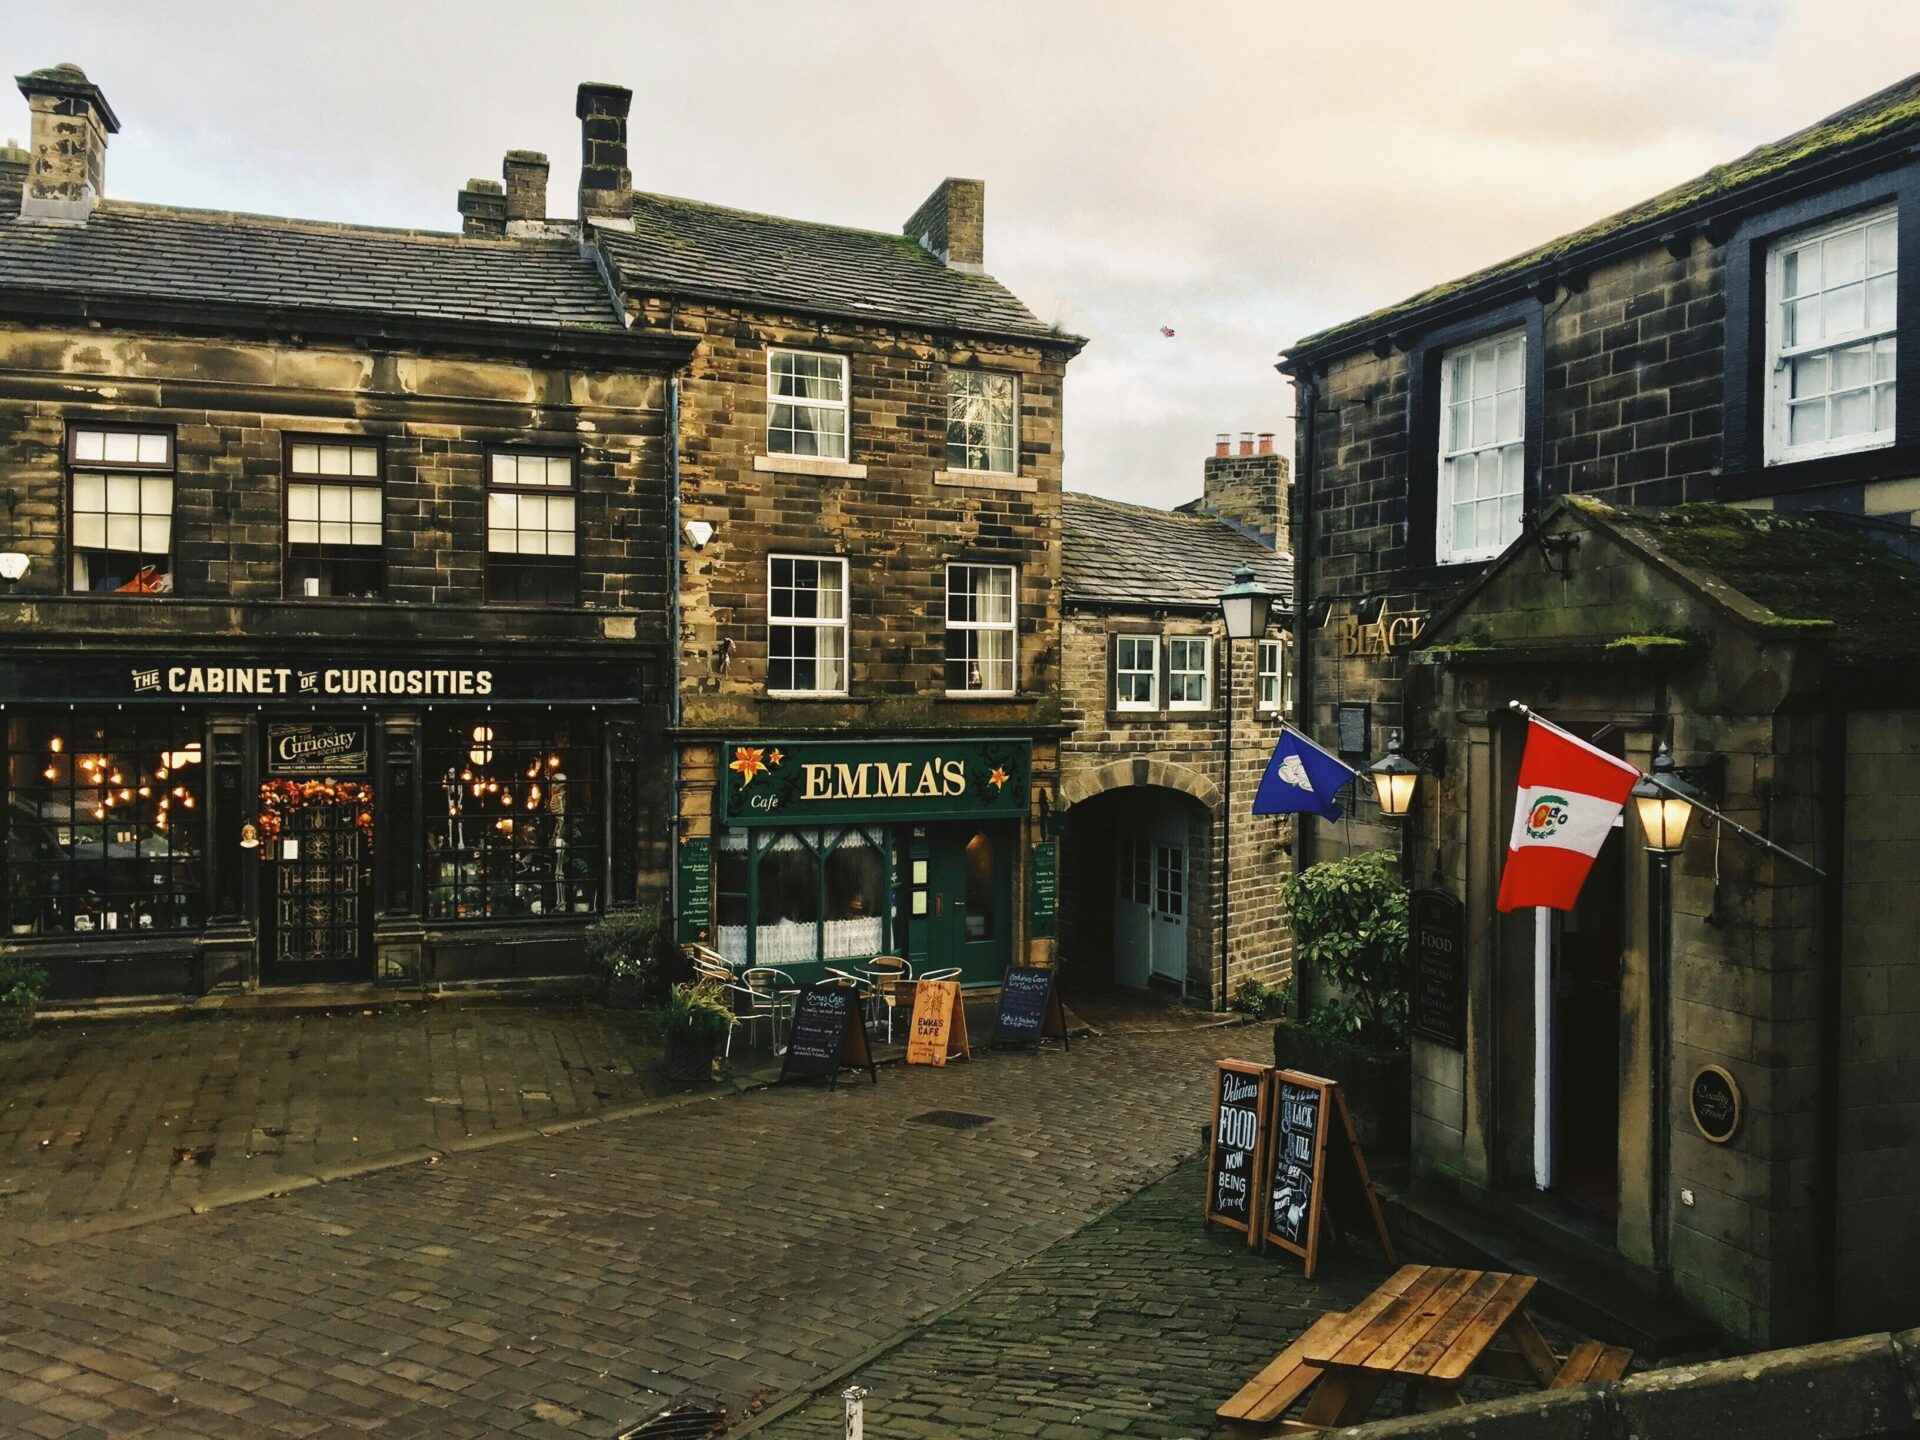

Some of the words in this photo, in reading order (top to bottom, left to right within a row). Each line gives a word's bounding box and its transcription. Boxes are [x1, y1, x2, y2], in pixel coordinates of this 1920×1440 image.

[133, 672, 160, 688] THE
[168, 667, 292, 694] CABINET
[300, 673, 318, 690] OF
[325, 669, 493, 695] CURIOSITIES
[279, 731, 357, 761] Curiosity
[299, 733, 312, 742] THE
[317, 745, 345, 757] SOCIETY
[800, 757, 967, 801] EMMA'S
[1421, 930, 1453, 953] FOOD
[917, 1018, 944, 1028] EMMA'S
[1223, 1073, 1258, 1103] Delicious
[1697, 1083, 1731, 1109] Quality
[1281, 1102, 1313, 1133] BLACK
[1700, 1103, 1728, 1121] Food
[1217, 1106, 1257, 1151] FOOD
[1284, 1132, 1310, 1164] BULL
[1225, 1151, 1244, 1170] NOW
[1287, 1164, 1301, 1178] OPEN
[1219, 1172, 1246, 1193] BEING
[1217, 1188, 1246, 1212] Served
